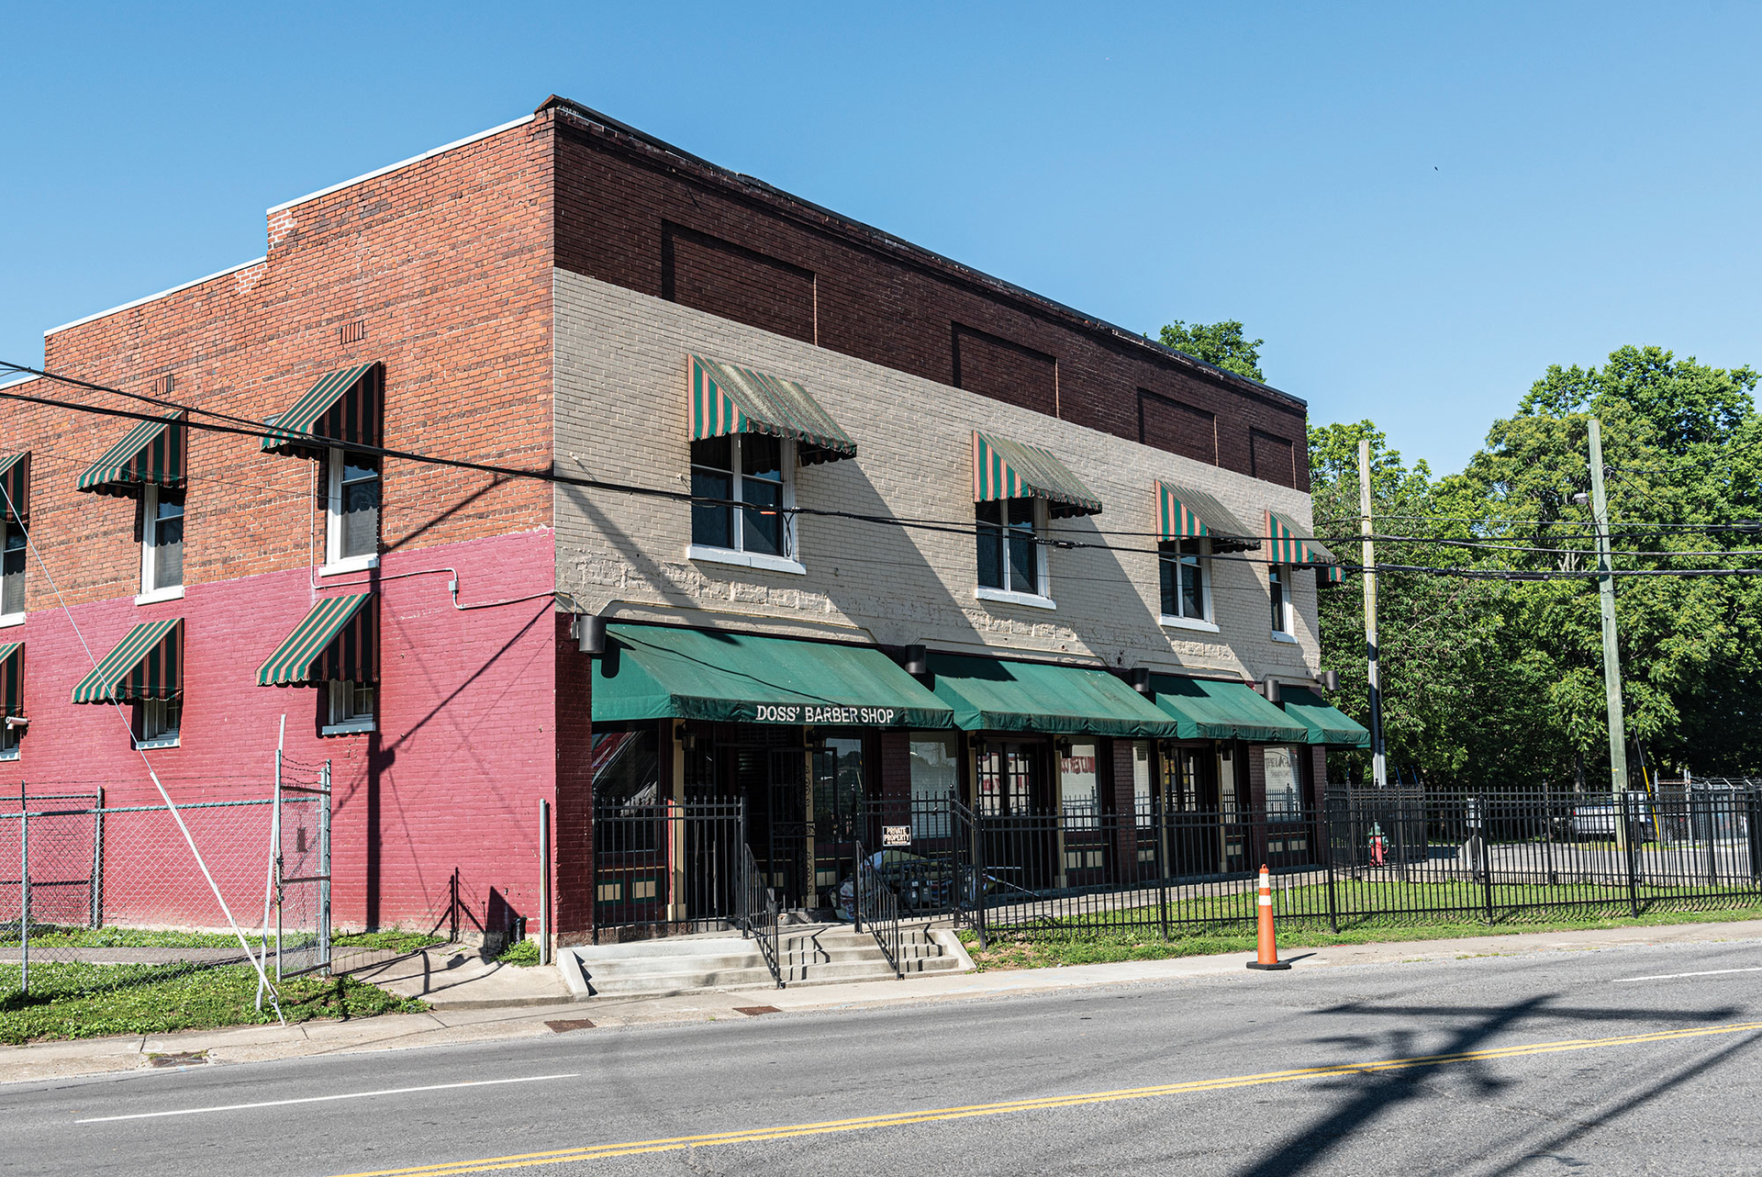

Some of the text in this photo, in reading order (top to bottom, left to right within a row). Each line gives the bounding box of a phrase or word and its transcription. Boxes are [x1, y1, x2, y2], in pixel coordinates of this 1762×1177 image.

[756, 705, 894, 724] DOSS' BARBER SHOP
[887, 827, 907, 835] PRIVATE
[884, 834, 910, 842] PROPERTY
